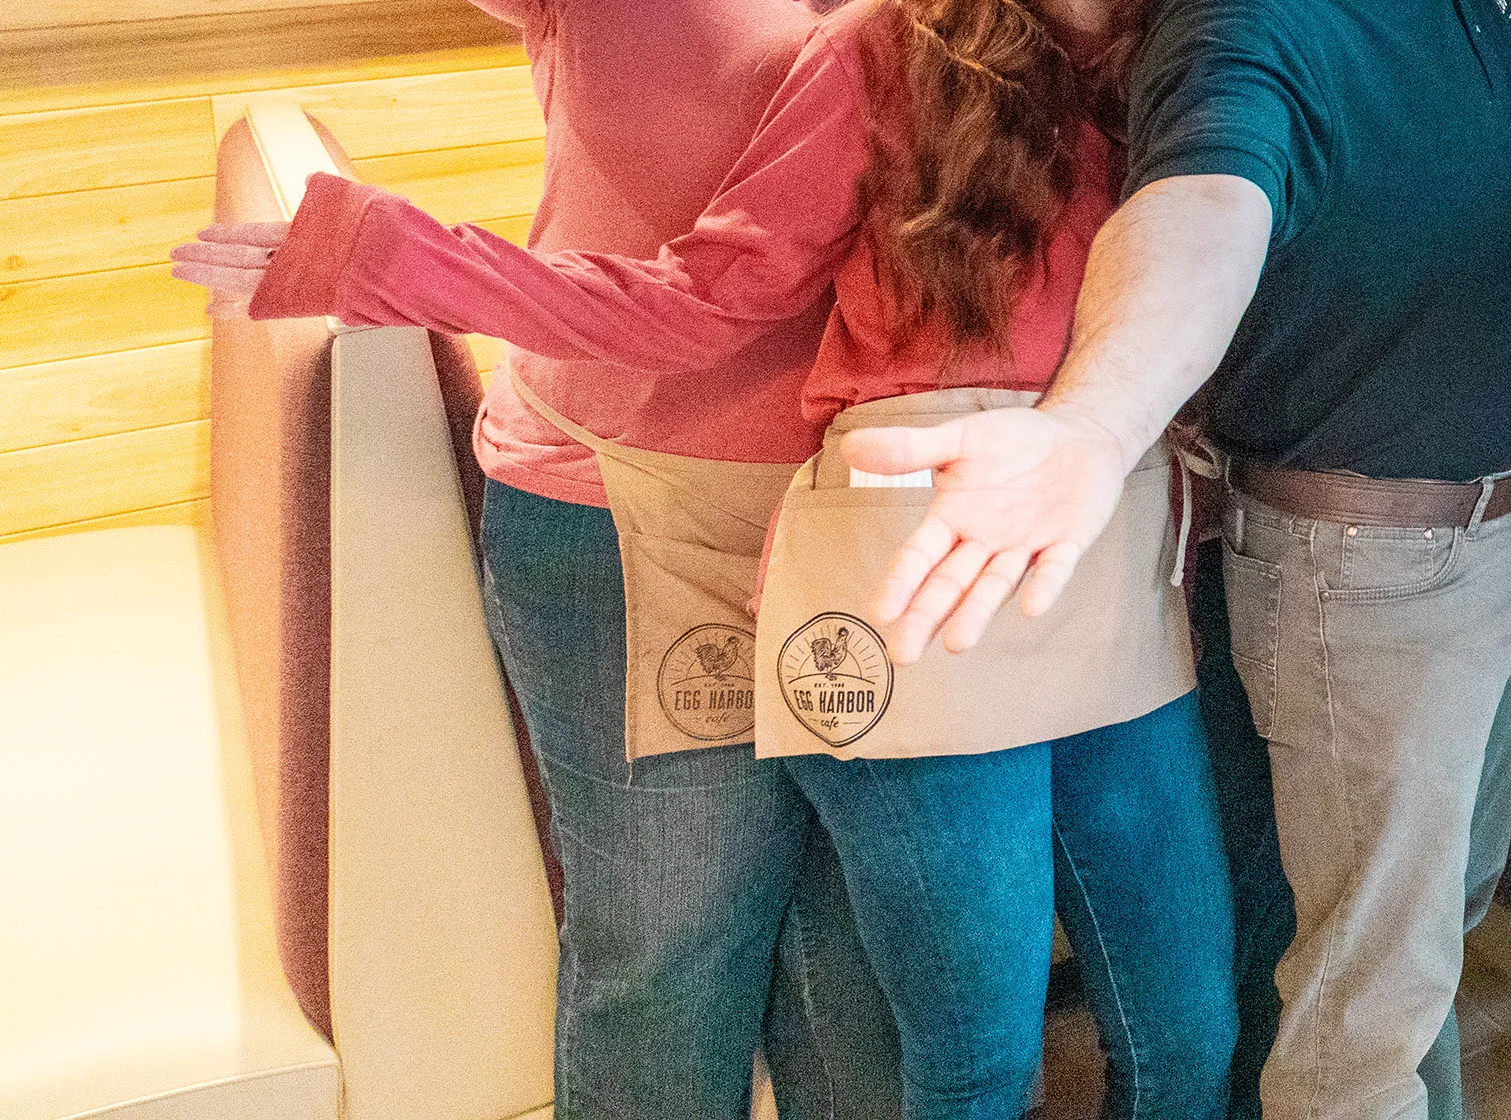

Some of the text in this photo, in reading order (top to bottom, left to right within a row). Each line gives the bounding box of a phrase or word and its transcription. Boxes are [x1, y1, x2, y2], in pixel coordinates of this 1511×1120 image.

[674, 690, 755, 711] EGG HARBO
[793, 689, 875, 714] EGG HARBOR
[820, 716, 840, 730] cafe
